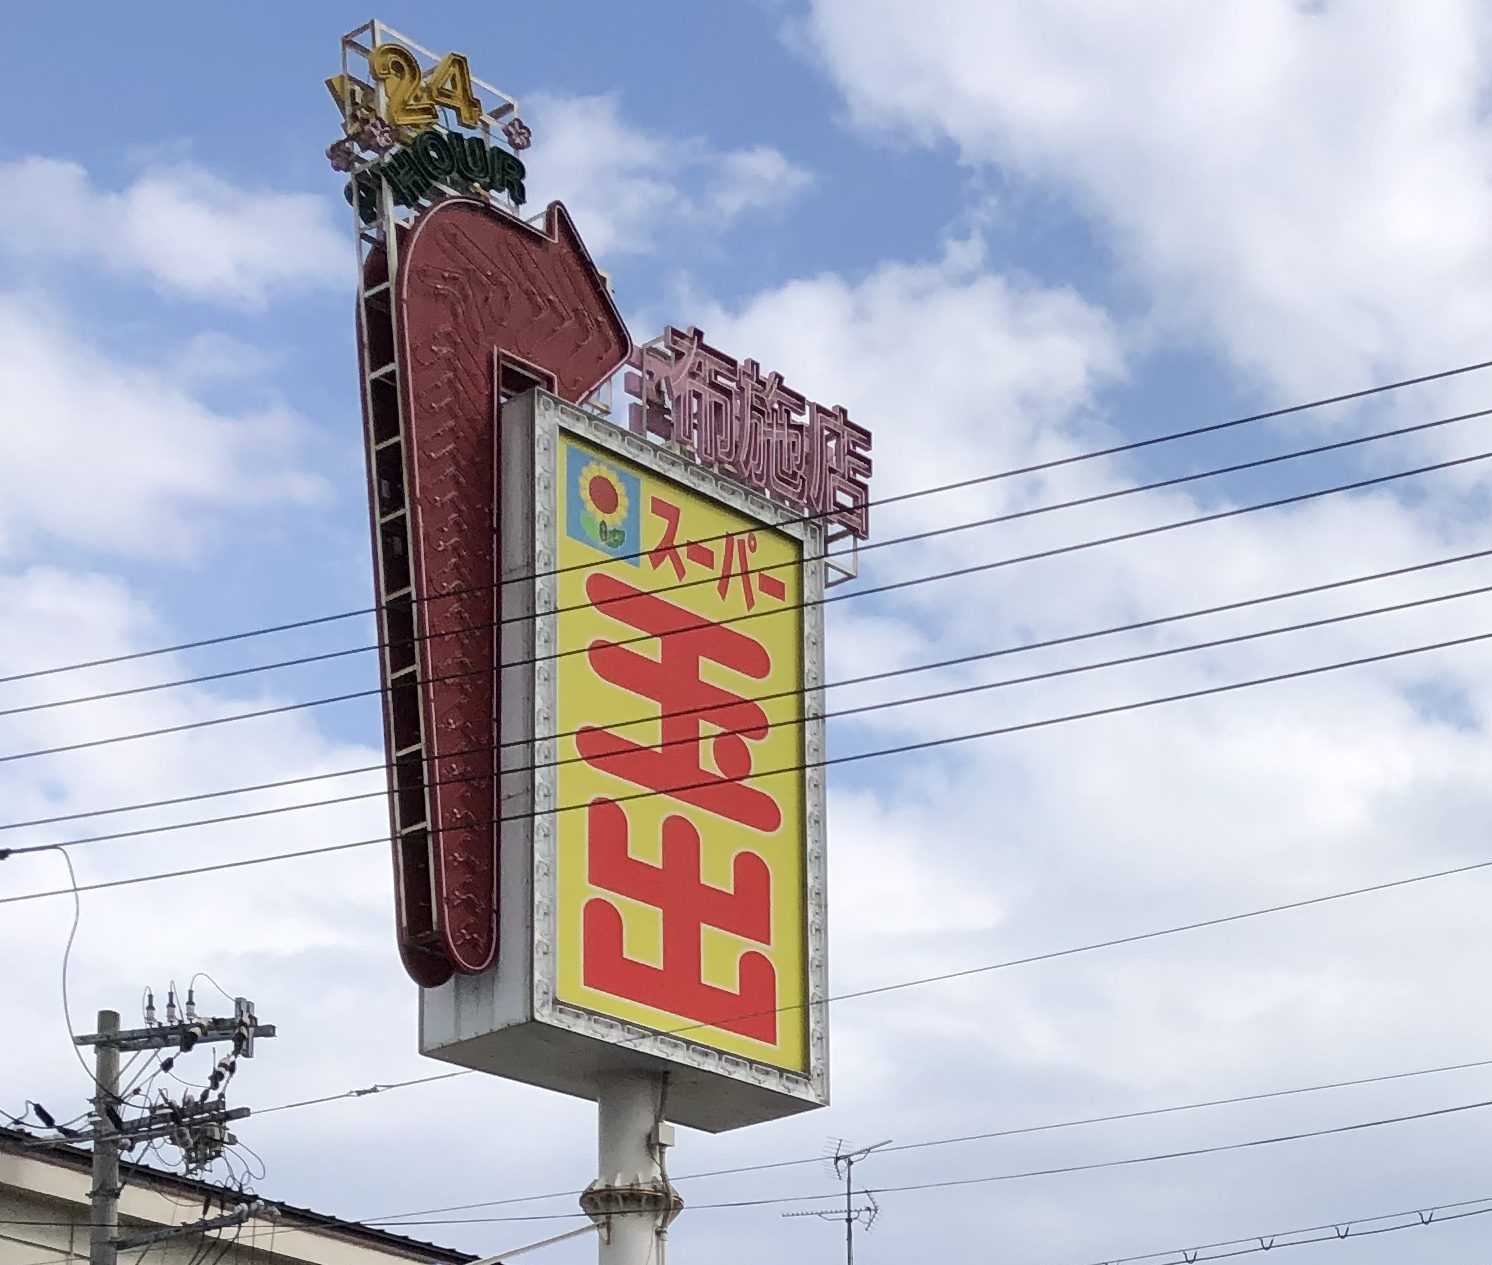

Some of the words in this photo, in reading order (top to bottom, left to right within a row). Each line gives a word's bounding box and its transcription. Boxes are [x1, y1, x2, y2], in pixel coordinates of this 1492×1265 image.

[369, 43, 483, 130] 24
[664, 325, 874, 542] 布施店
[648, 496, 785, 611] スーパー
[575, 571, 782, 1046] 玉出
